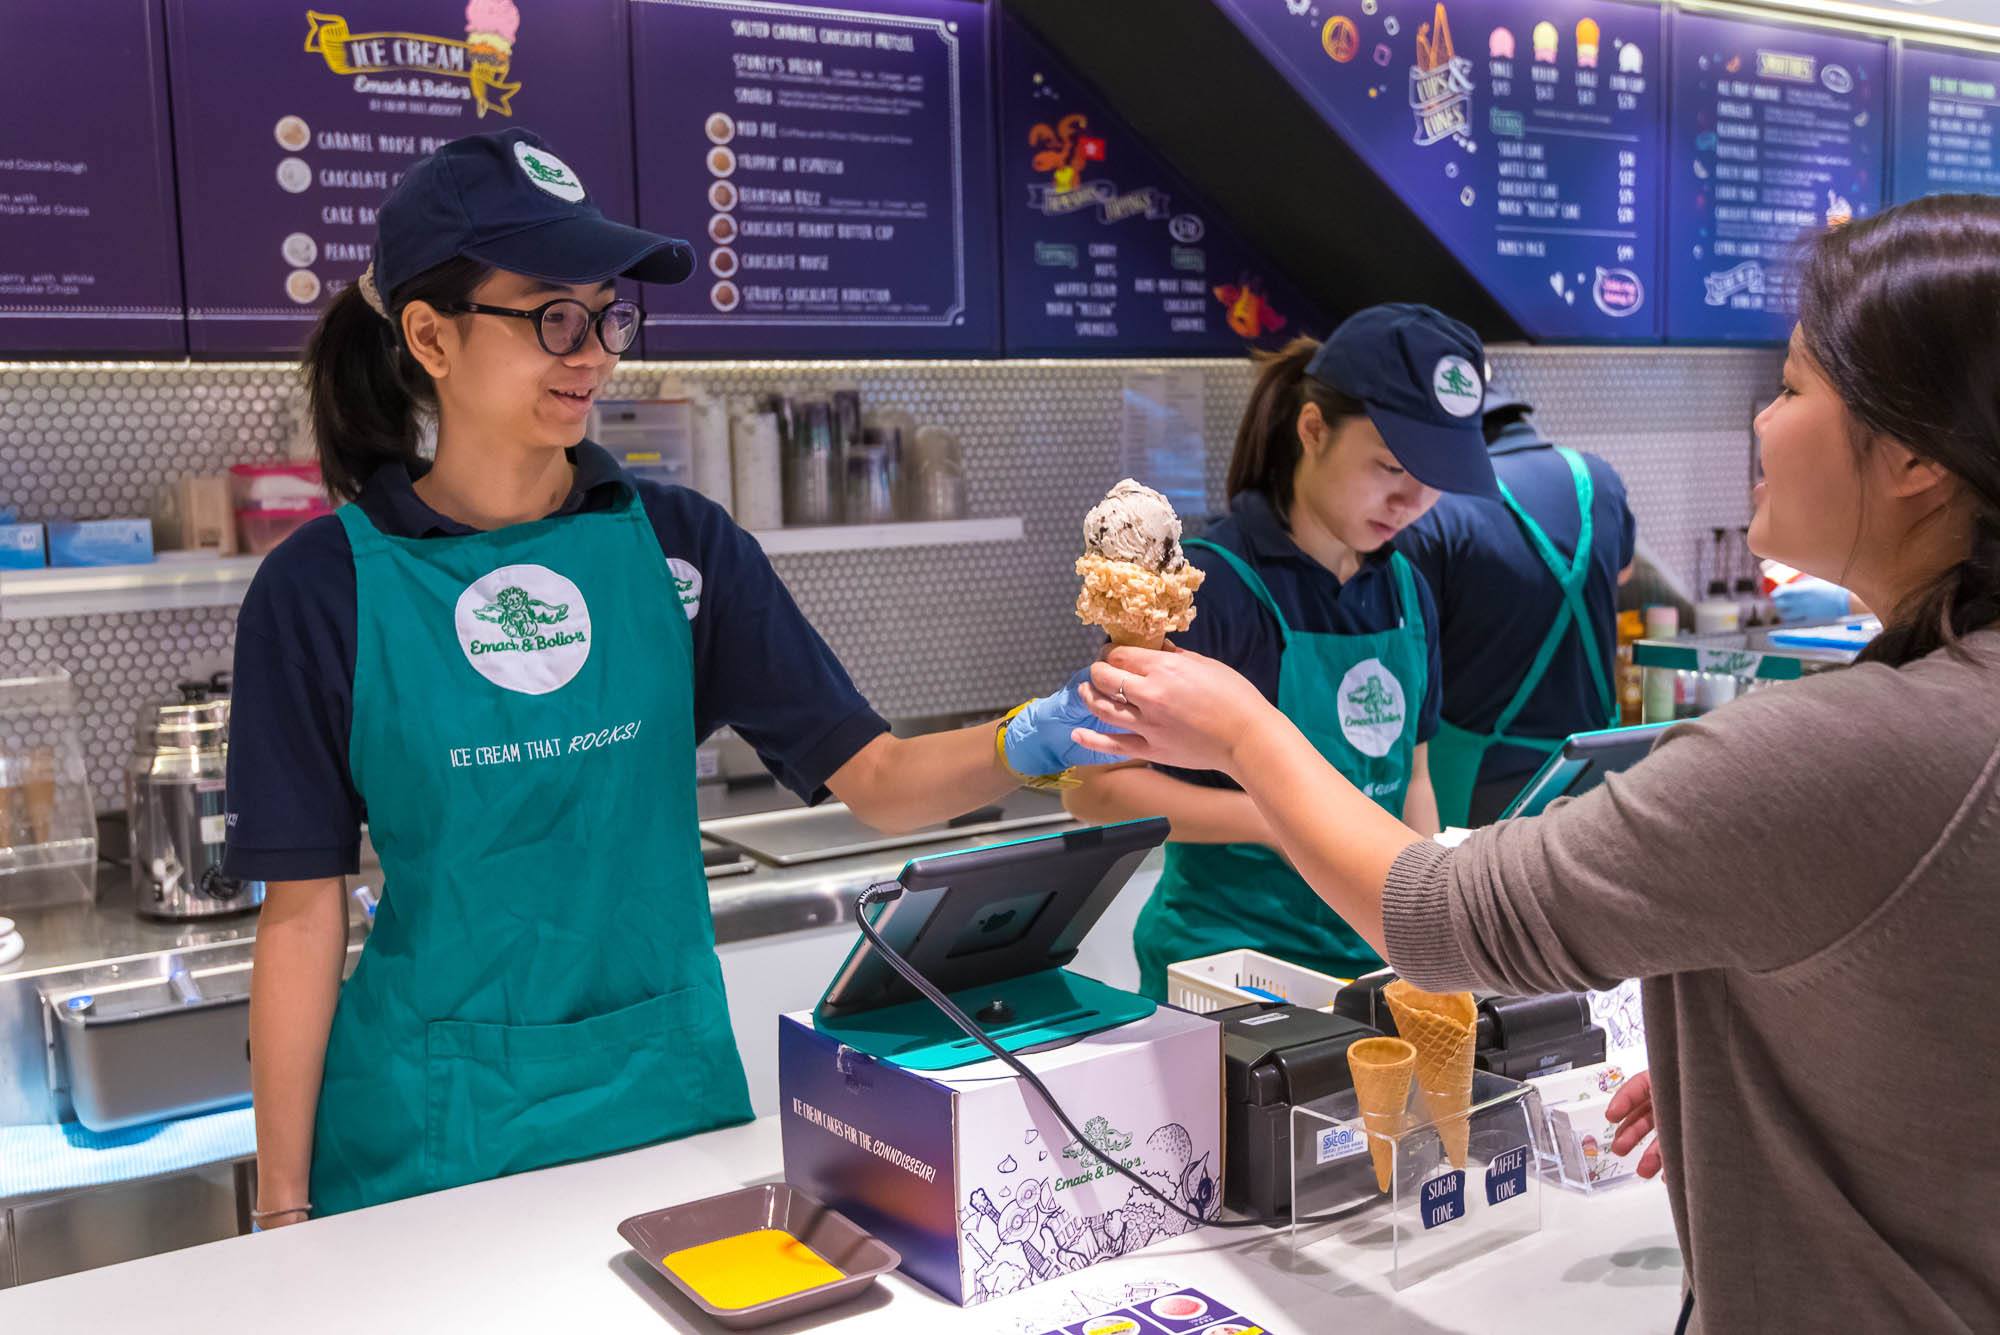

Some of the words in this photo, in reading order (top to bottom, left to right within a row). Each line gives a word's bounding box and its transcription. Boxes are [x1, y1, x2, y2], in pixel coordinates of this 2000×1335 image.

[351, 40, 388, 67] ICE
[393, 39, 465, 72] CREAM
[317, 132, 373, 152] CARAMEL
[0, 159, 14, 170] nd
[320, 169, 387, 189] CHOCOLATE
[0, 204, 24, 215] hips
[322, 206, 353, 225] CAKE
[359, 206, 379, 225] BA
[325, 243, 371, 261] PEANUT
[0, 274, 25, 285] erry
[0, 284, 43, 295] ocolate
[470, 638, 519, 655] Emack
[521, 639, 534, 652] &
[450, 748, 471, 767] ICE
[475, 743, 521, 767] CREAM
[525, 738, 561, 757] THAT
[568, 720, 641, 754] ROCKS!
[793, 1097, 803, 1116] ICE
[803, 1102, 823, 1127] CREAM
[823, 1113, 844, 1138] CAKES
[844, 1123, 858, 1145] FOR
[858, 1130, 873, 1152] THE
[873, 1139, 937, 1184] CONNOISSEUR!
[1323, 1128, 1356, 1150] star
[1491, 1150, 1522, 1178] WAFFLE
[1055, 1170, 1093, 1192] Emack
[1095, 1166, 1104, 1179] &
[1428, 1174, 1457, 1200] SUGAR
[1496, 1178, 1517, 1201] CONE
[1432, 1201, 1454, 1225] CONE
